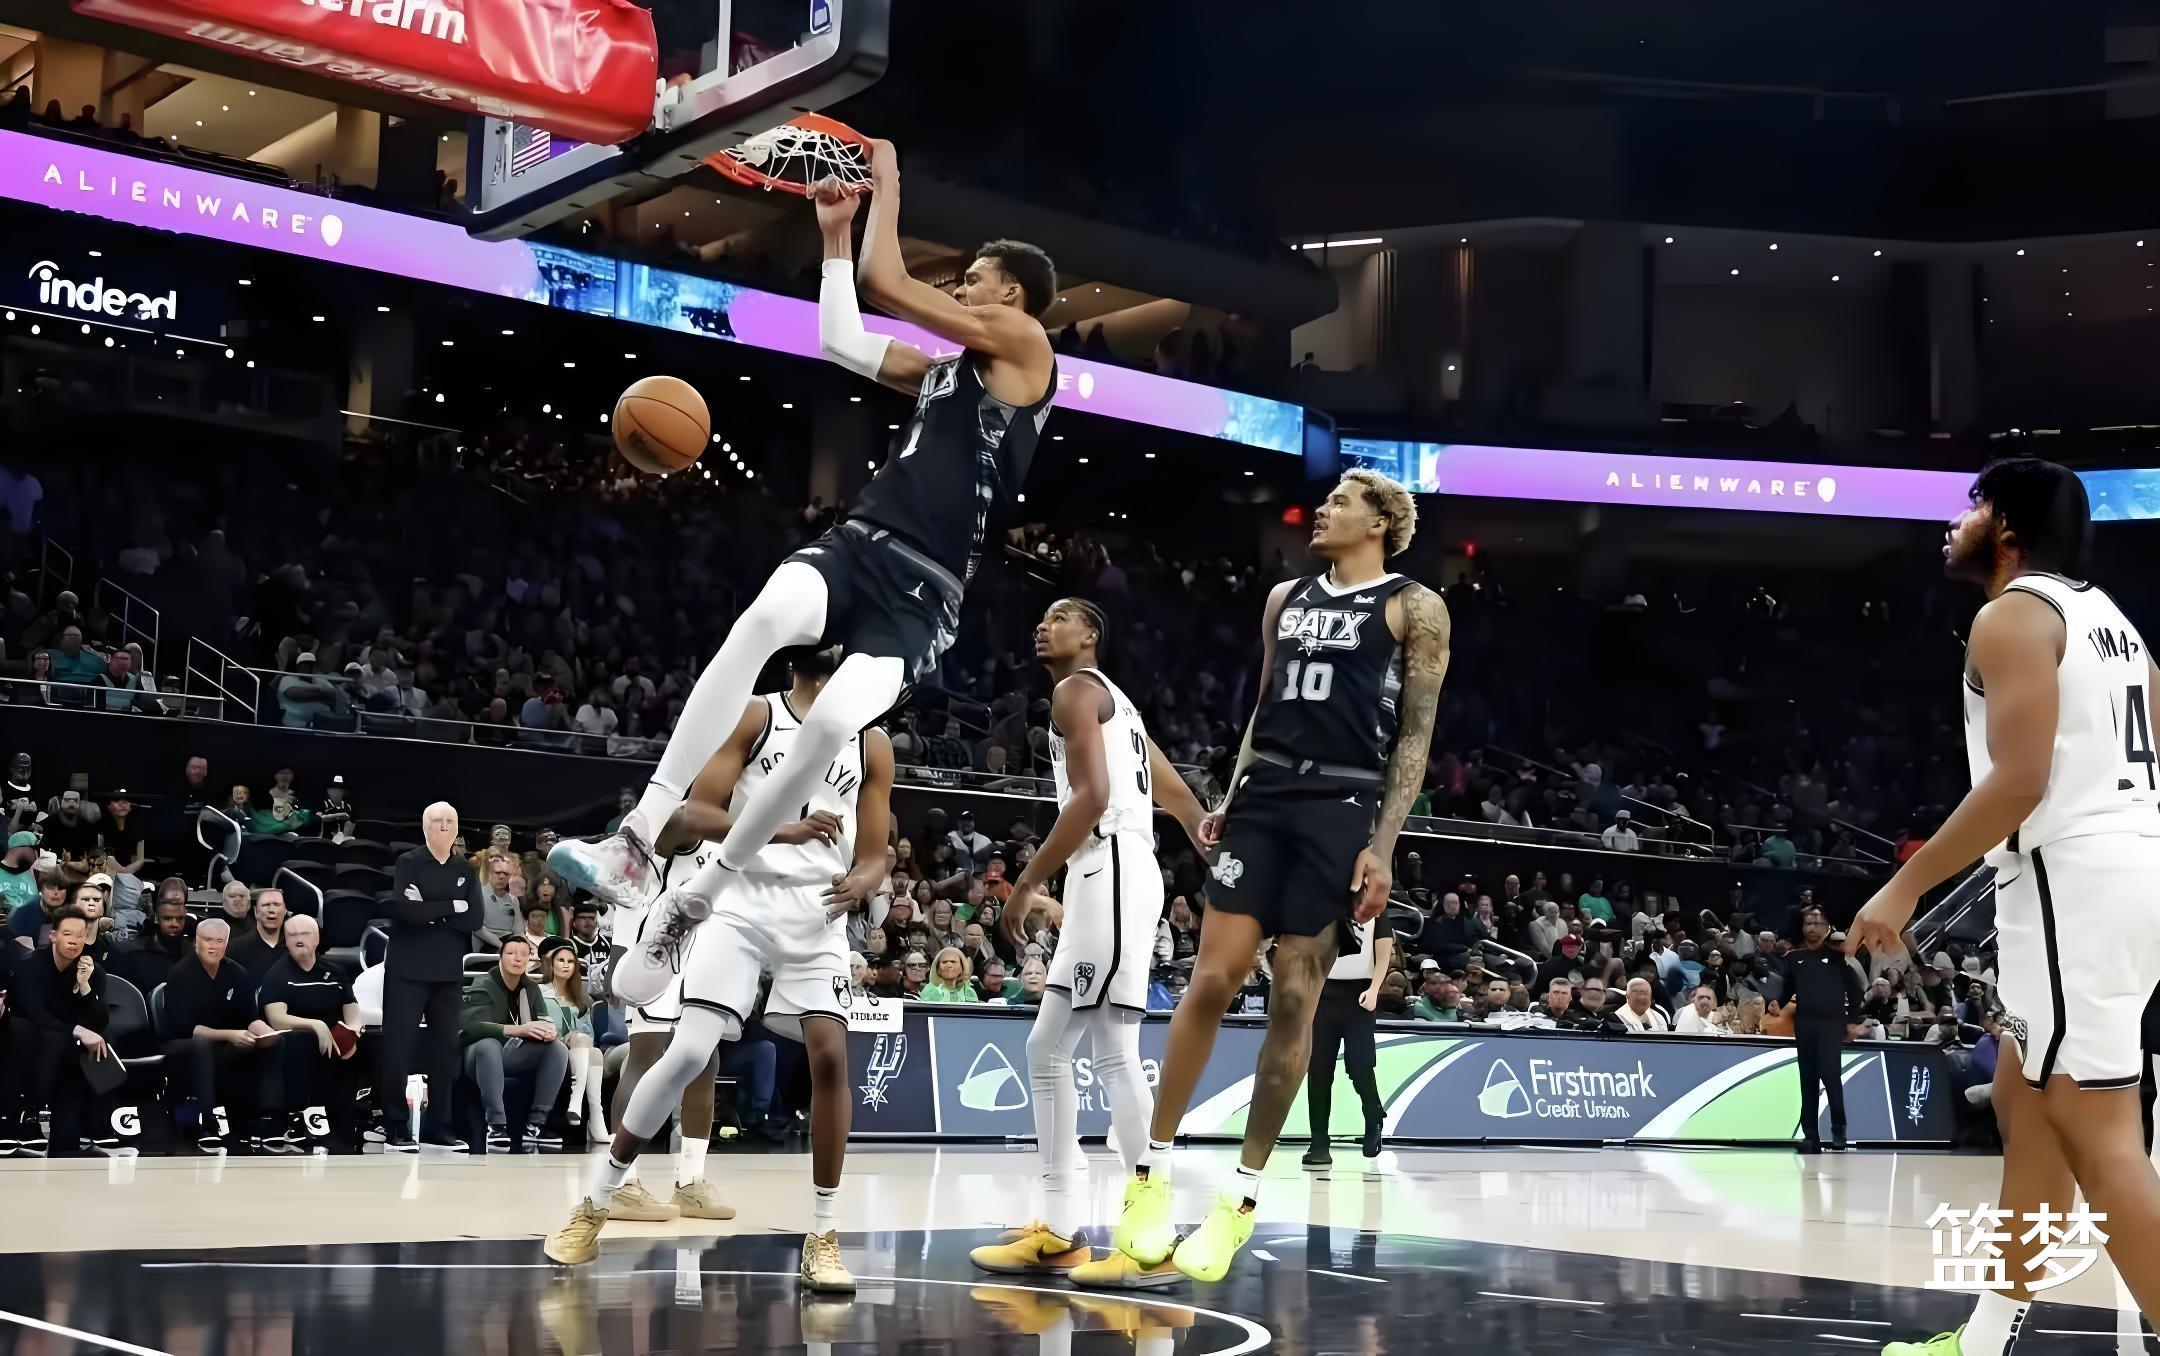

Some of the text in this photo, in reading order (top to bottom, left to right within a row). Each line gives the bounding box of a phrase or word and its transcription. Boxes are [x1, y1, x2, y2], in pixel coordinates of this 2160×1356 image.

[43, 163, 308, 234] ALIENWARE
[1605, 471, 1811, 497] ALIENWARE
[1278, 607, 1371, 649] SATX
[1280, 660, 1335, 701] 10
[1529, 1059, 1657, 1098] Firstmark
[1535, 1098, 1582, 1119] Credit
